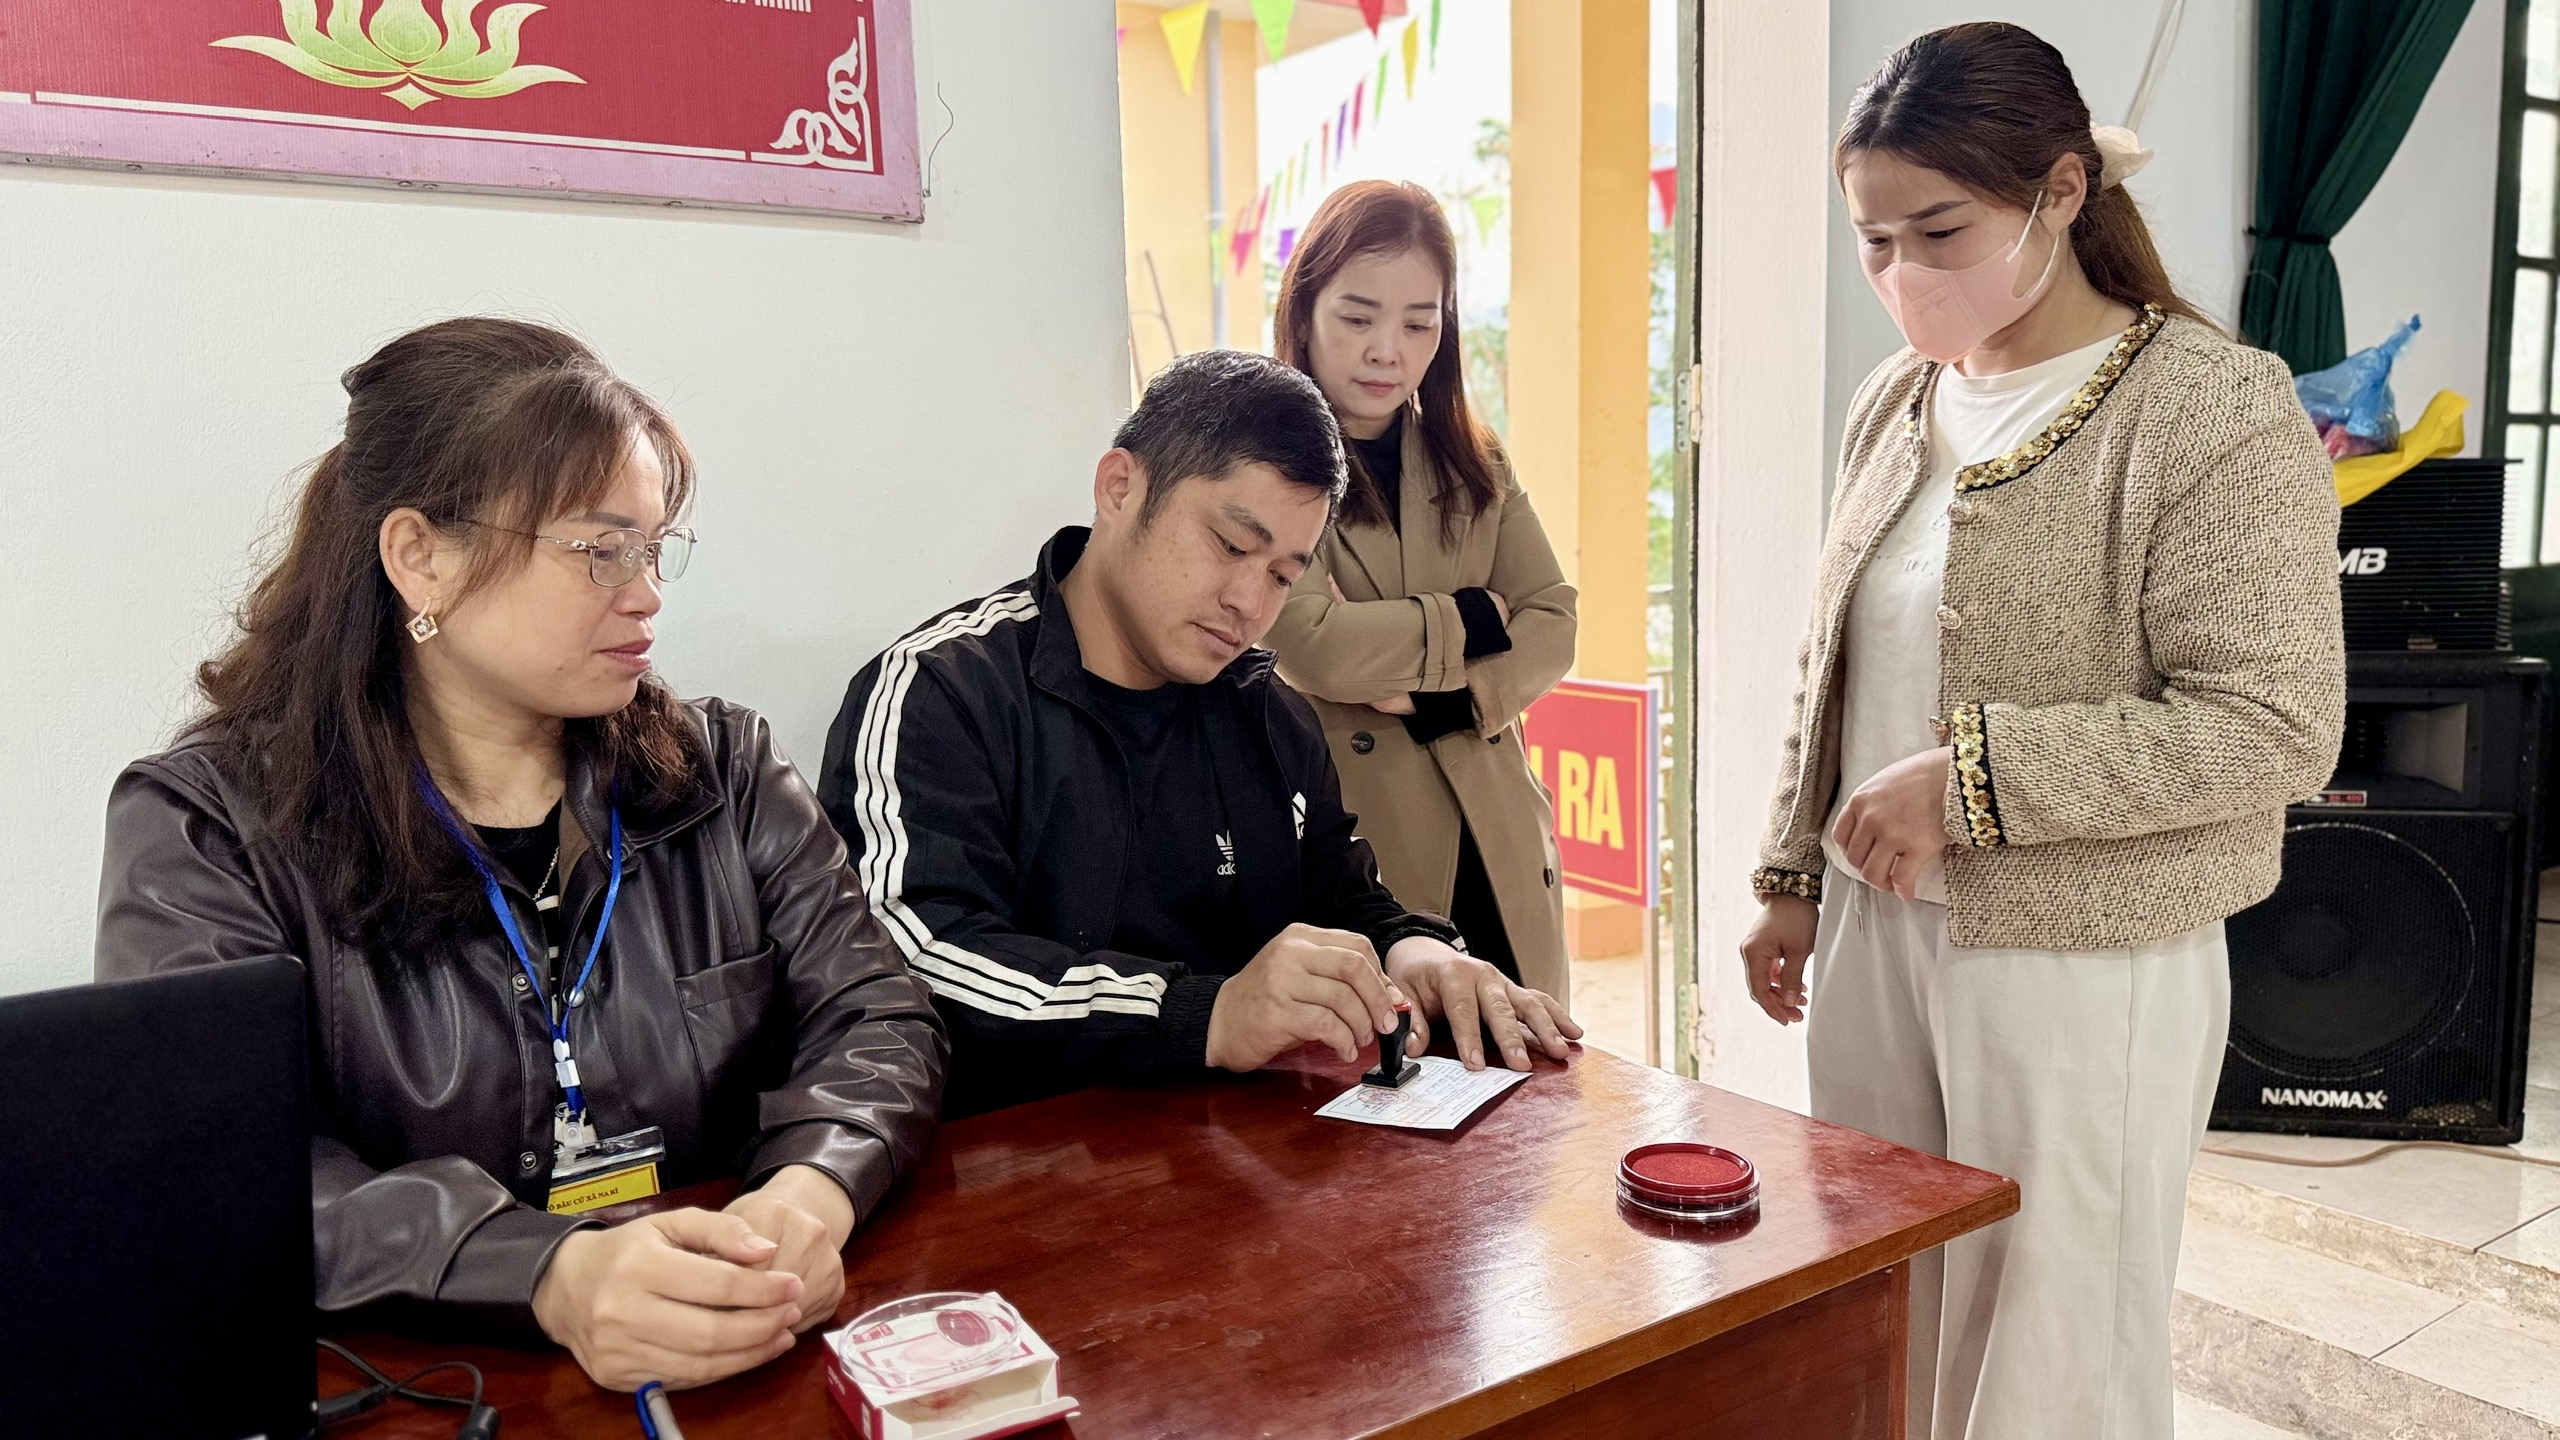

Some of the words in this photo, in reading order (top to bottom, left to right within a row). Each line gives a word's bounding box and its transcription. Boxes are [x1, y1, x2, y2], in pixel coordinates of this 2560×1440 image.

[1558, 749, 1625, 851] RA
[2261, 1087, 2385, 1110] NANOMAX
[598, 1190, 610, 1199] NA
